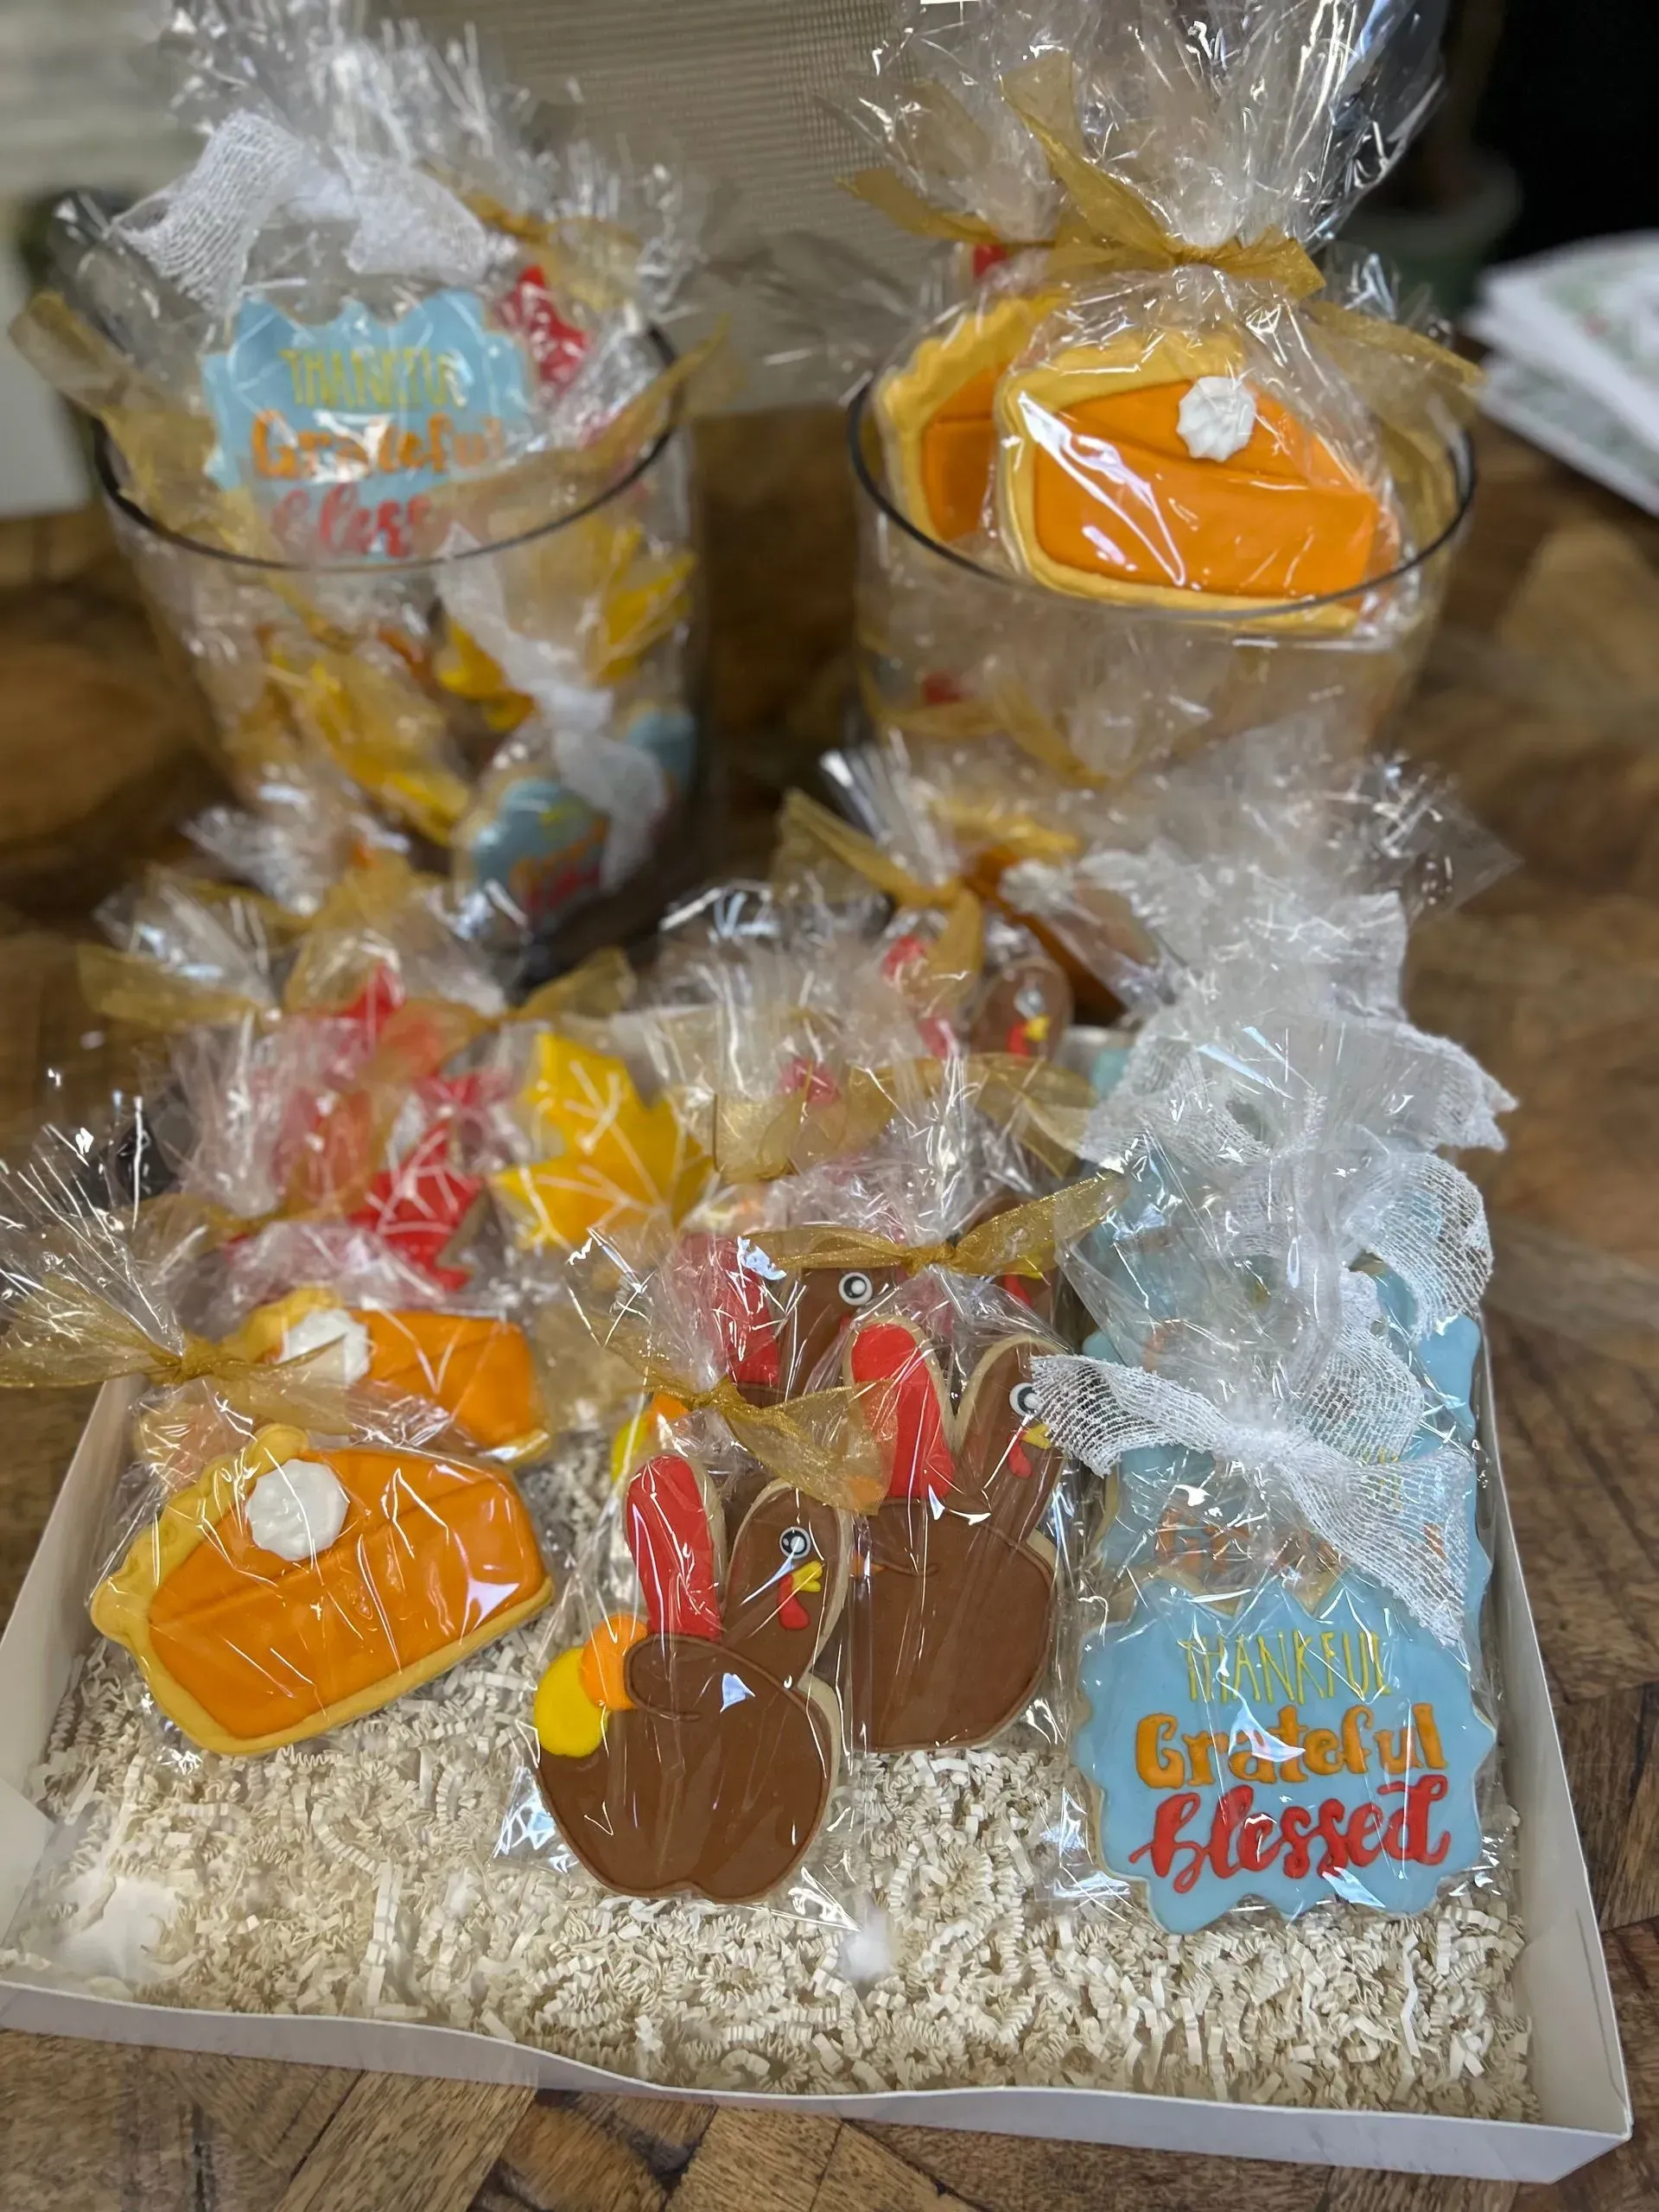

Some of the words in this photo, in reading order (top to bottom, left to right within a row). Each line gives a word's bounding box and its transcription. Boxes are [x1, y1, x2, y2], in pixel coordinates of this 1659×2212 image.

[1182, 1630, 1391, 1704] THANKFUL
[1135, 1704, 1448, 1789] Grateful
[1129, 1775, 1451, 1893] blessed
